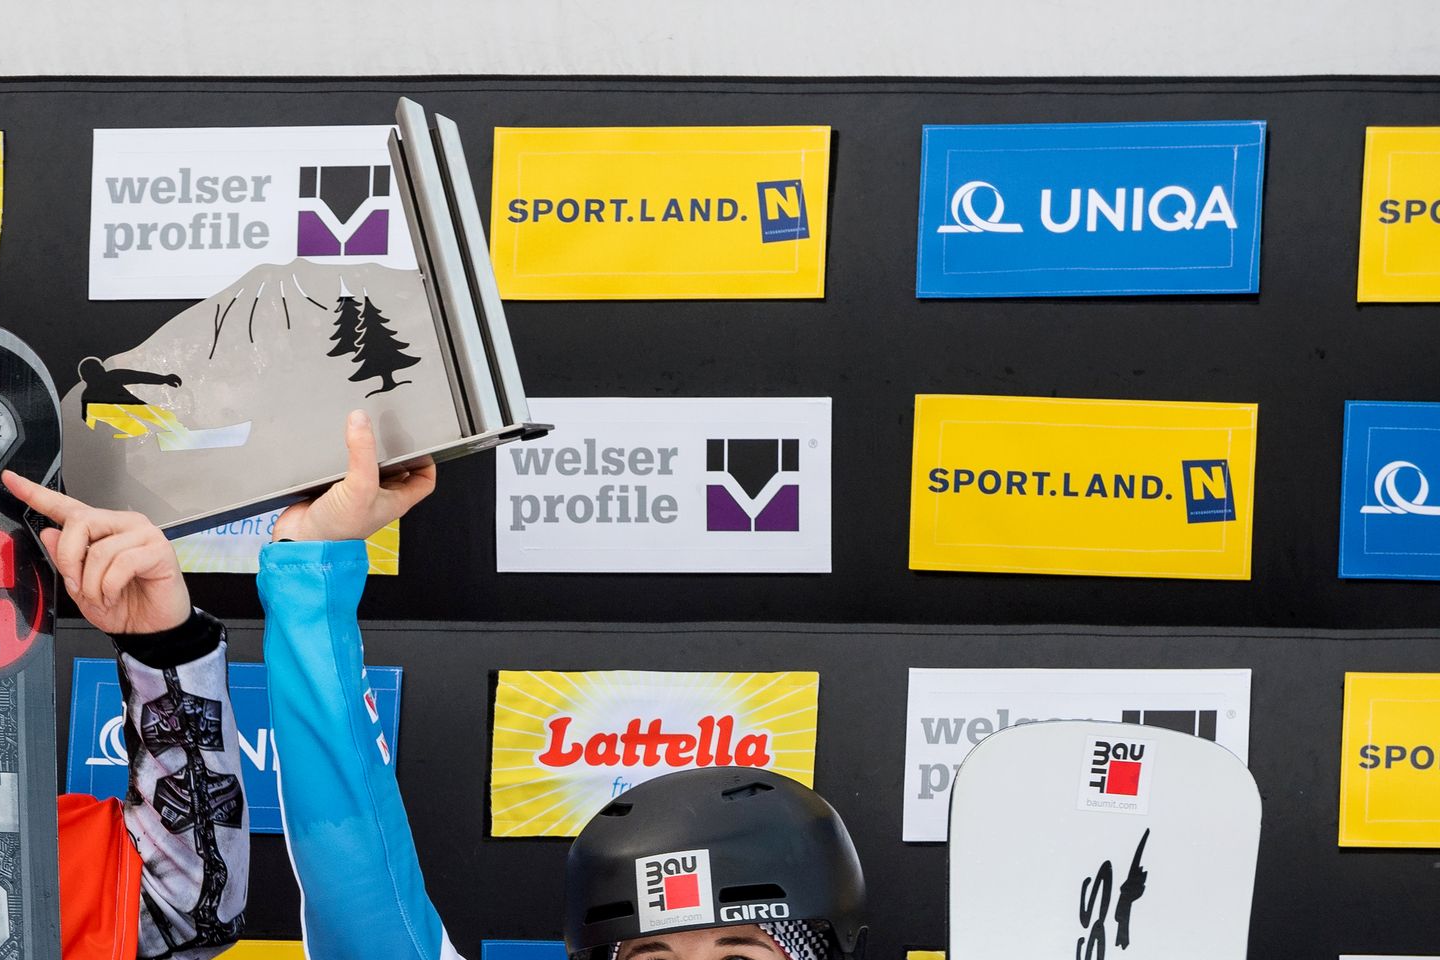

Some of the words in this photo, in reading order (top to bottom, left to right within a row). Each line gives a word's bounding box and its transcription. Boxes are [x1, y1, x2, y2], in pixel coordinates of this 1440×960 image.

[104, 166, 273, 205] welser
[506, 196, 748, 224] SPORT.LAND.
[1041, 184, 1238, 234] UNIQA
[102, 212, 271, 260] profile
[509, 440, 681, 477] welser
[927, 466, 1174, 501] SPORT.LAND.
[509, 484, 680, 533] profile
[538, 715, 771, 768] Lattella
[719, 902, 791, 922] GIRO
